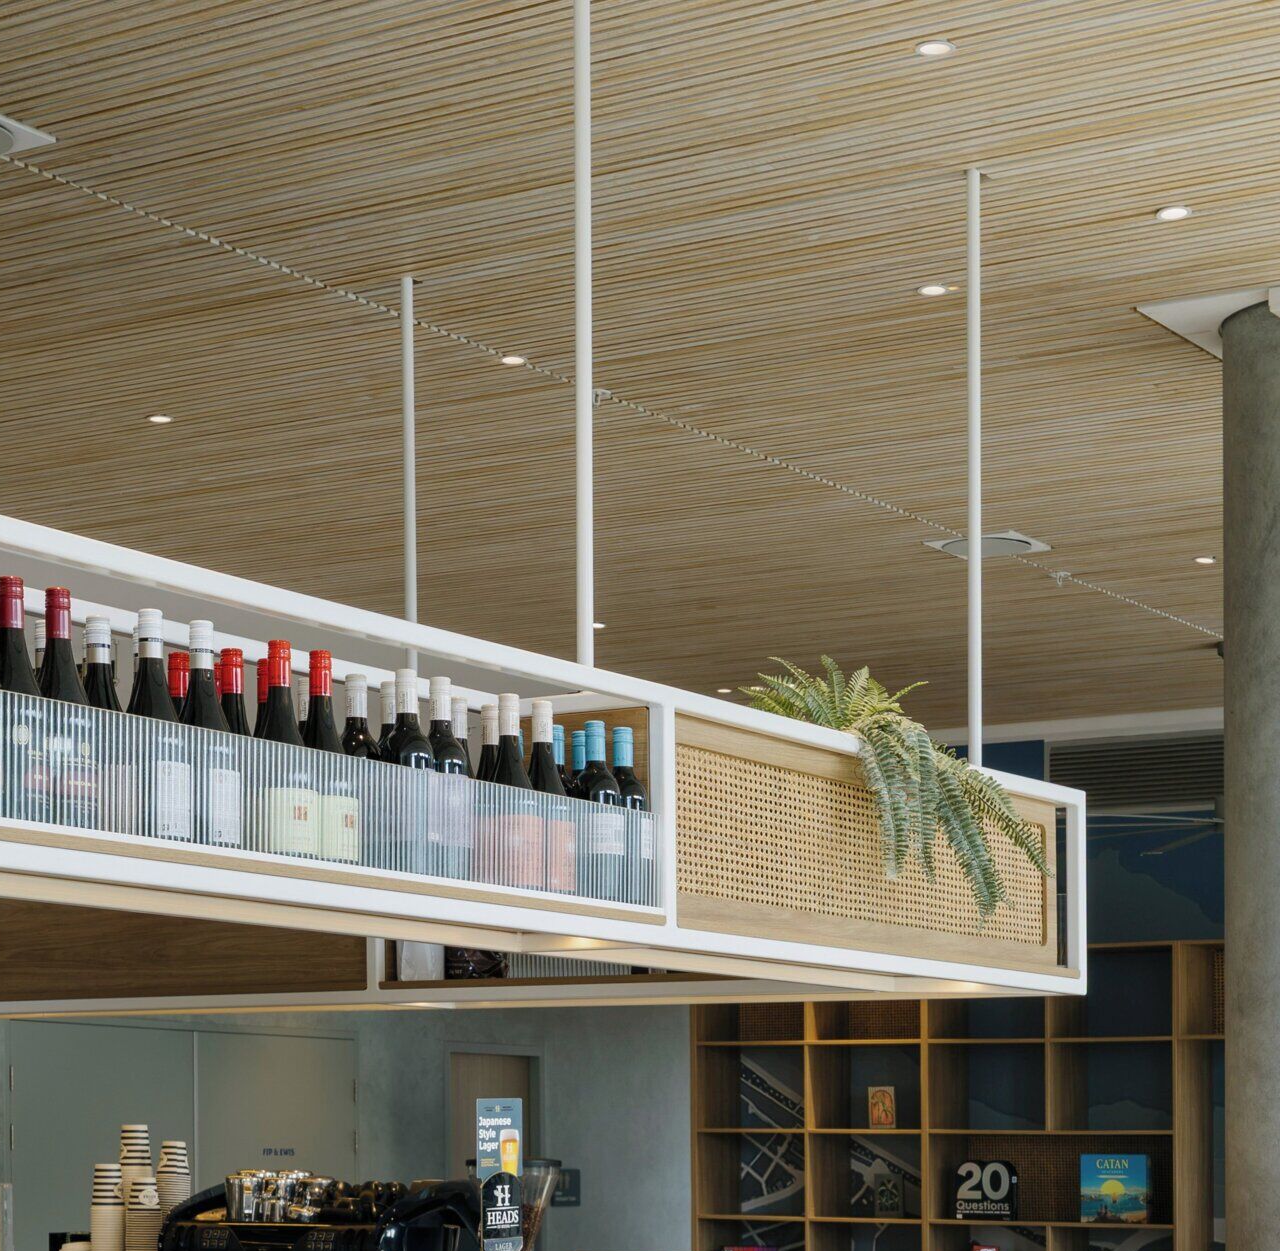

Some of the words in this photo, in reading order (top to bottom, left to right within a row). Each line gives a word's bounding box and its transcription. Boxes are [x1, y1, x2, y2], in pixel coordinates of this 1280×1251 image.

[478, 1116, 512, 1127] Japanese
[478, 1128, 497, 1140] Style
[478, 1140, 499, 1152] Lager
[1096, 1158, 1129, 1169] CATAN
[957, 1162, 1010, 1200] 20
[956, 1200, 1010, 1211] Questions
[486, 1211, 519, 1225] HEADS
[495, 1242, 513, 1250] LAGER
